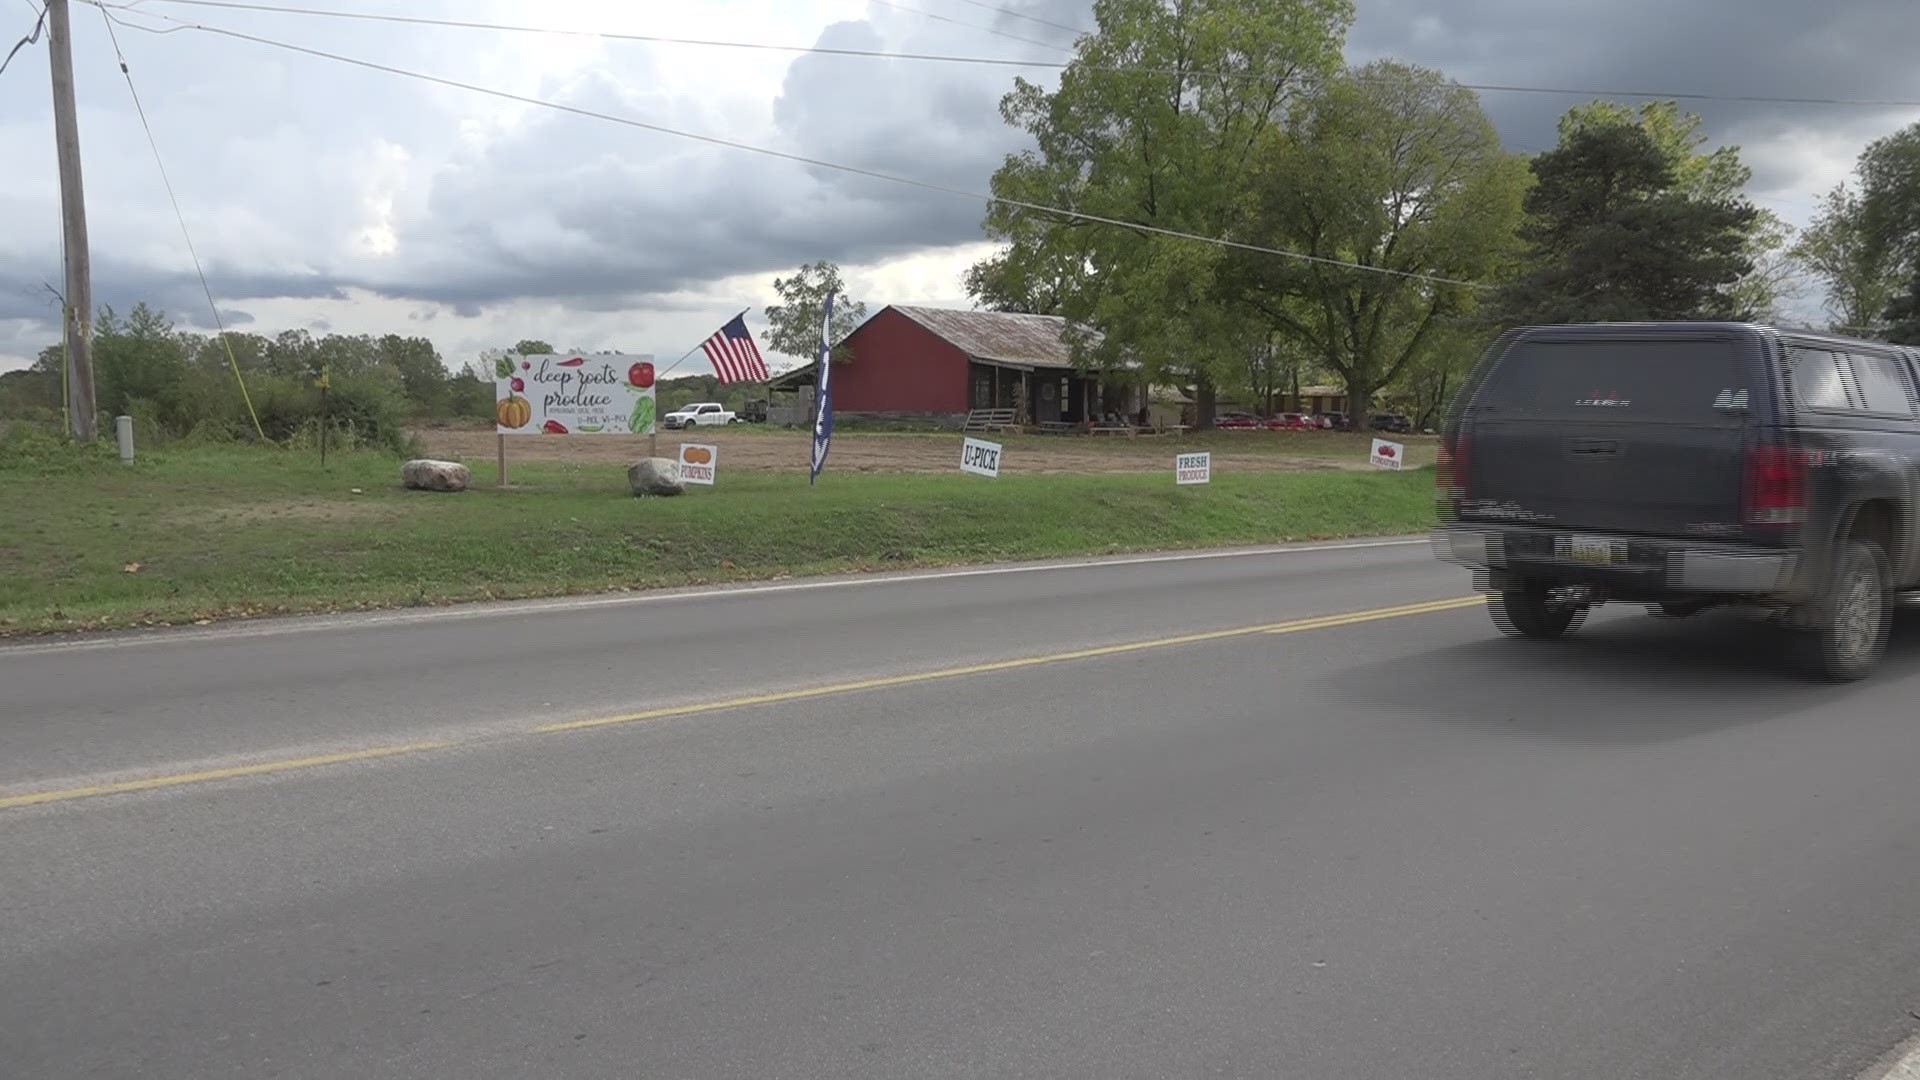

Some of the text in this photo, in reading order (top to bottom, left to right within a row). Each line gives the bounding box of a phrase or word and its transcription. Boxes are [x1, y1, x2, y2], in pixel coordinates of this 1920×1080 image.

[533, 358, 618, 395] deep roots
[543, 382, 612, 417] produce
[964, 444, 998, 471] U-PICK
[1179, 455, 1207, 469] FRESH
[680, 464, 713, 481] PUMPKINS
[1178, 469, 1208, 481] PRODUCE
